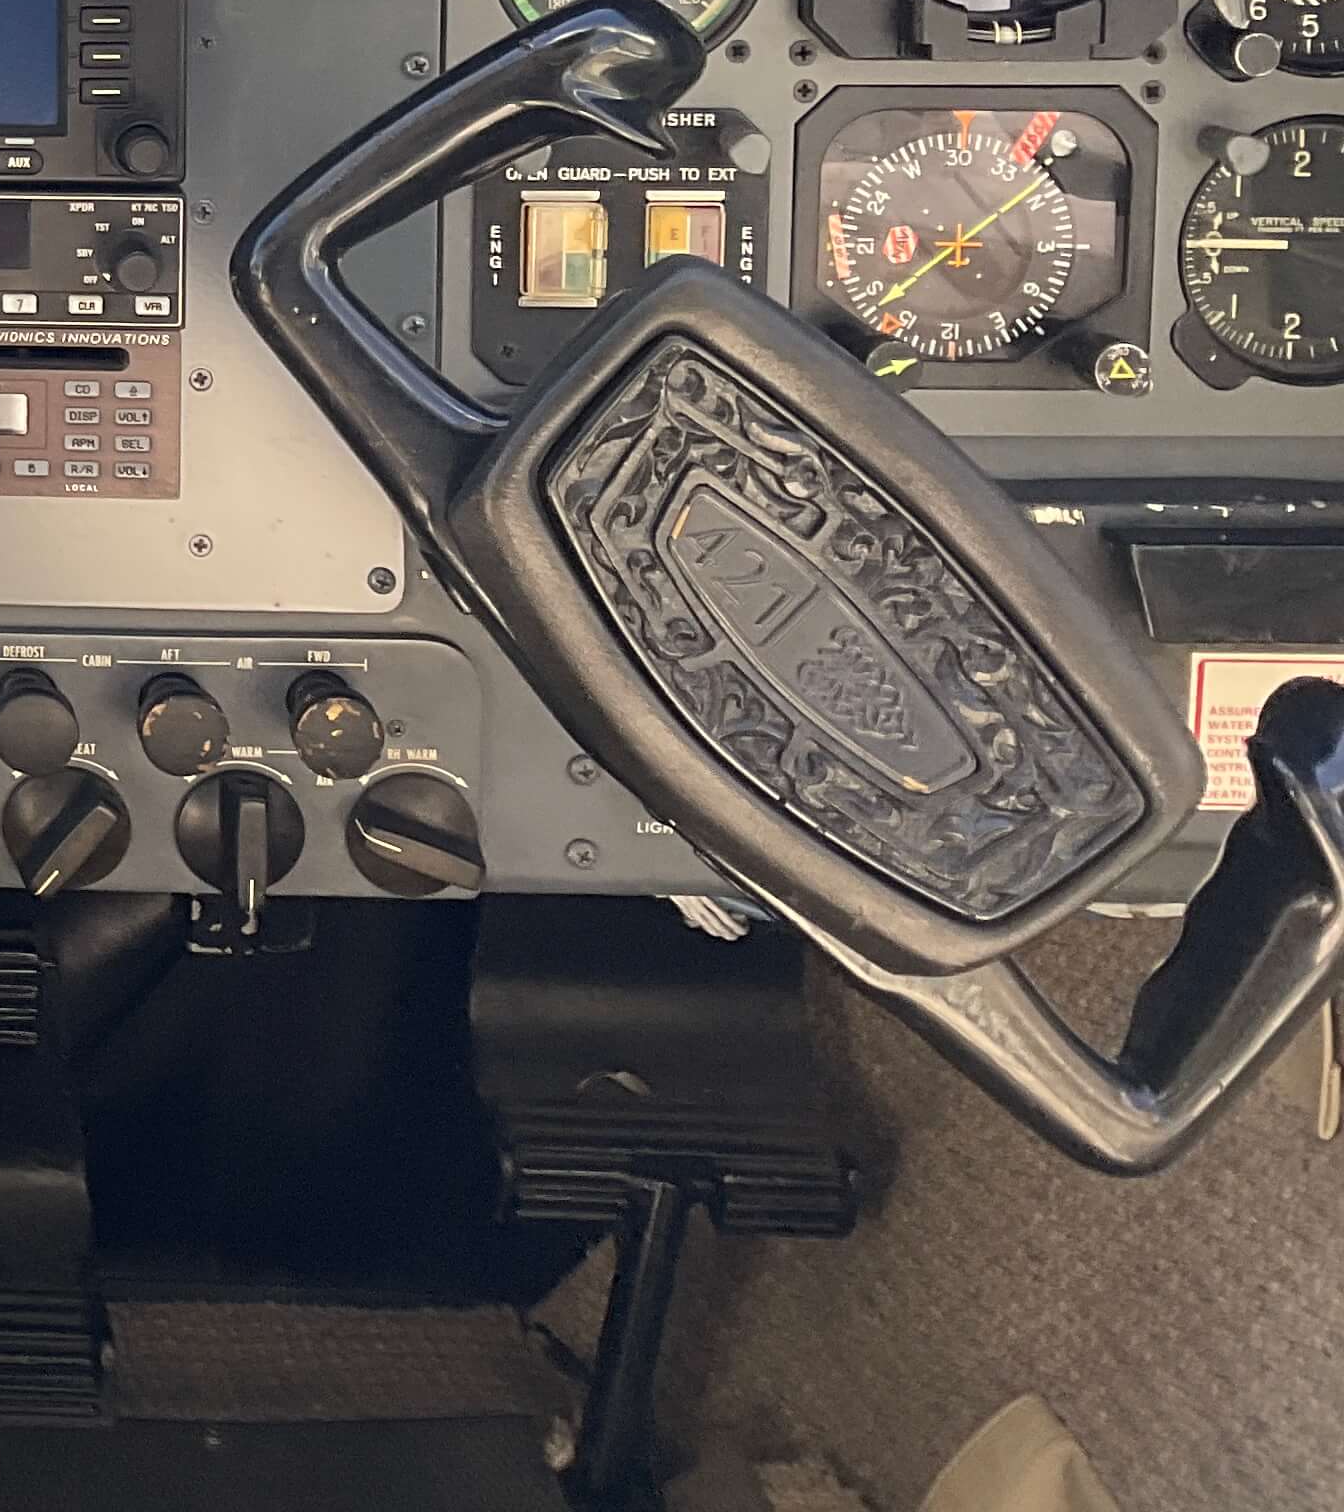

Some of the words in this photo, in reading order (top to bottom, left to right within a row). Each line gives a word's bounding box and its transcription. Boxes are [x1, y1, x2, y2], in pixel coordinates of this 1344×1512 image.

[680, 168, 700, 180] TO
[708, 168, 737, 180] EXT
[1251, 217, 1303, 226] VERTICAL
[61, 332, 170, 346] INNOVATIONS
[3, 646, 45, 658] DEFROST
[308, 651, 330, 663] FWD
[1208, 721, 1253, 729] WATER
